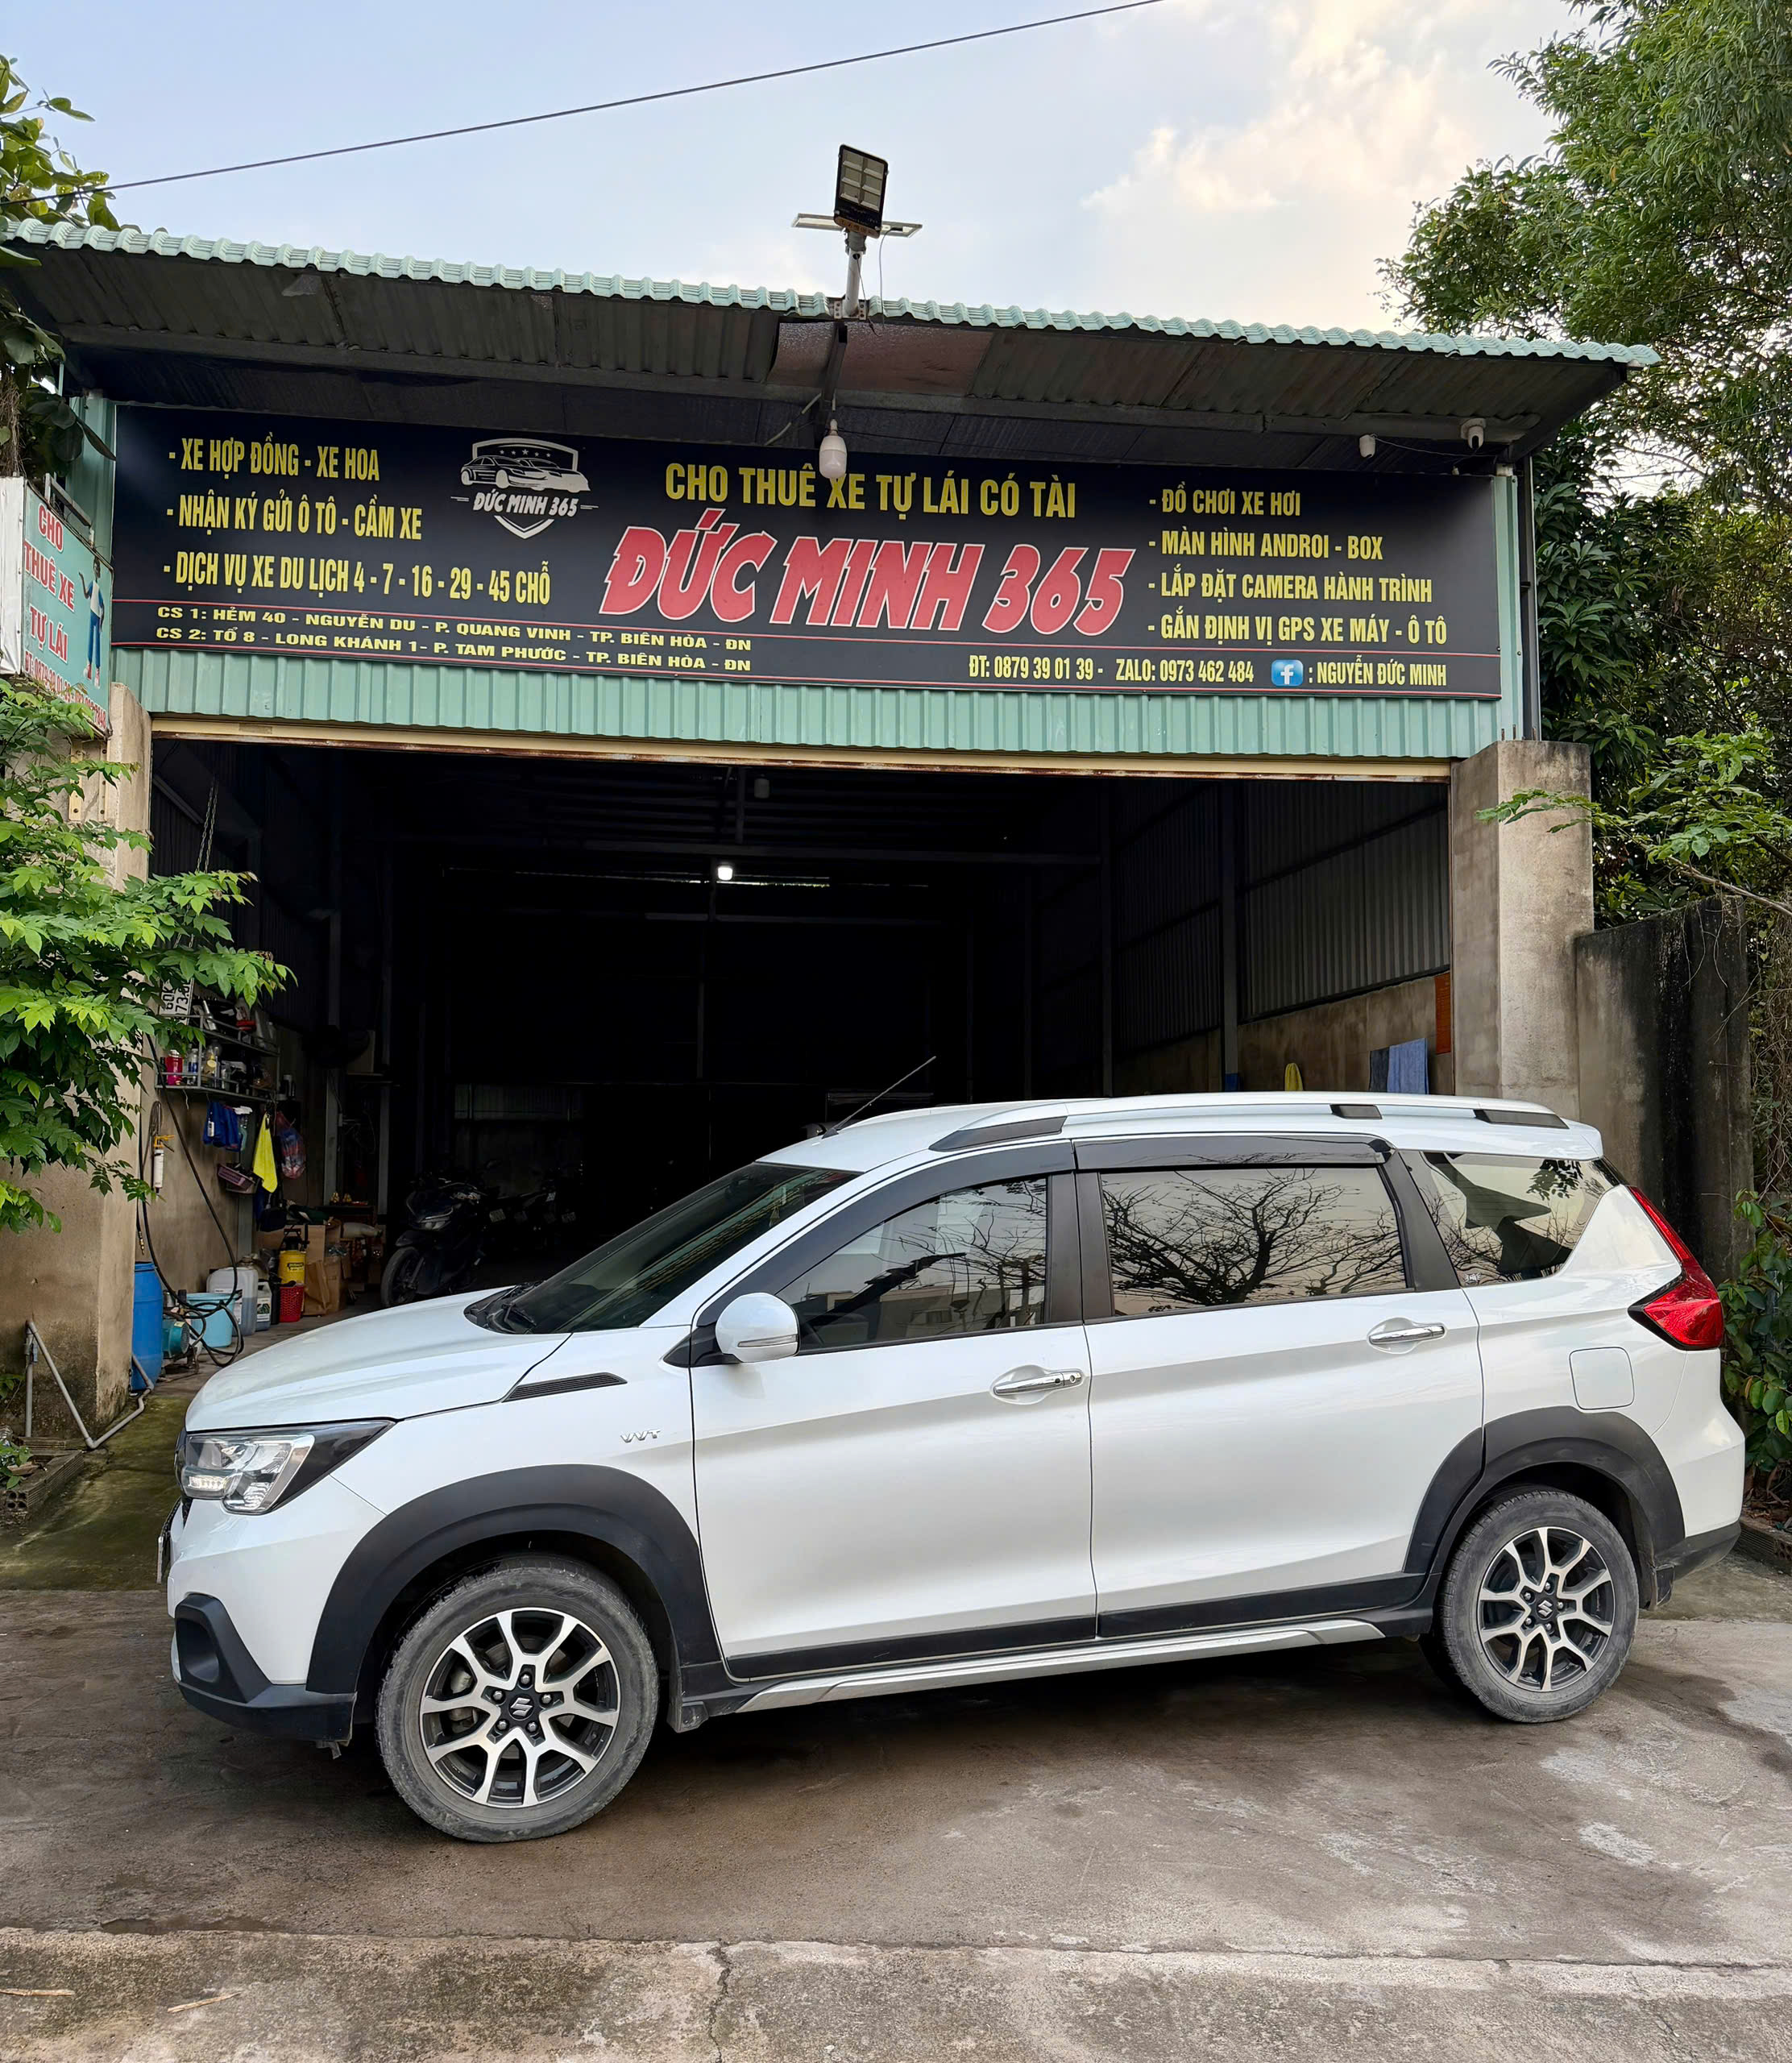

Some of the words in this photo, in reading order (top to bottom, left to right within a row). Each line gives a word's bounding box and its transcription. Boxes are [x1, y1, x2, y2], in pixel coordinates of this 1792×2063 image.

[180, 438, 203, 470] XE
[209, 437, 245, 479] HỢP
[250, 432, 298, 475] ĐỒNG
[317, 446, 338, 478] XE
[345, 447, 380, 481] HOA
[178, 489, 230, 535] NHẬN
[234, 492, 258, 529] KÝ
[263, 489, 292, 532] GỬI
[298, 494, 309, 533] Ô
[315, 496, 336, 534] TÔ
[355, 494, 394, 538] CẦM
[399, 507, 422, 540] XE
[473, 488, 507, 512] ĐỨC
[506, 495, 548, 515] MINH
[549, 496, 579, 517] 365
[666, 463, 728, 501] CHO
[739, 463, 816, 507] THUÊ
[827, 473, 865, 509] XE
[876, 472, 915, 520] TỰ
[923, 470, 968, 515] LÁI
[980, 472, 1019, 517] CÓ
[1030, 475, 1076, 518] TÀI
[1162, 481, 1187, 513] ĐỒ
[1193, 488, 1234, 514] CHƠI
[1242, 492, 1263, 515] XE
[1270, 491, 1300, 516] HƠI
[38, 504, 63, 552] CHO
[1162, 526, 1205, 555] MÀN
[1211, 527, 1255, 556] HÌNH
[1260, 533, 1329, 558] ANDROI
[1348, 536, 1383, 560] BOX
[24, 538, 56, 596] THUÊ
[59, 570, 74, 612] XE
[176, 551, 218, 592] DỊCH
[224, 554, 247, 593] VỤ
[251, 554, 274, 588] XE
[280, 557, 303, 590] DU
[309, 558, 348, 598] LỊCH
[353, 562, 363, 593] 4
[383, 563, 394, 594] 7
[412, 565, 432, 597] 16
[450, 567, 471, 600] 29
[477, 583, 483, 591] -
[488, 570, 509, 602] 45
[515, 561, 550, 604] CHỖ
[599, 508, 777, 622] ĐỨC
[769, 536, 985, 632] MINH
[981, 543, 1136, 636] 365
[1161, 564, 1196, 597] LẮP
[1201, 569, 1236, 603] ĐẶT
[1242, 575, 1318, 600] CAMERA
[1324, 571, 1373, 601] HÀNH
[1379, 572, 1433, 603] TRÌNH
[29, 604, 48, 650] TỰ
[48, 620, 68, 663] LÁI
[156, 628, 182, 638] CS
[189, 629, 205, 640] 2:
[213, 626, 239, 641] TỔ
[243, 633, 255, 642] 8
[276, 633, 327, 646] LONG
[334, 636, 400, 651] KHÁNH
[434, 642, 448, 653] P.
[456, 644, 495, 656] TAM
[501, 645, 566, 660] PHƯỚC
[587, 651, 611, 662] TP.
[618, 653, 662, 666] BIÊN
[668, 654, 705, 668] HÒA
[724, 660, 750, 670] ĐN
[158, 607, 183, 619] CS
[190, 608, 206, 620] 1:
[214, 606, 255, 621] HẺM
[262, 612, 285, 623] 40
[305, 613, 384, 629] NGUYỄN
[390, 619, 415, 630] DU
[435, 621, 450, 633] P.
[457, 624, 520, 637] QUANG
[526, 628, 570, 640] VINH
[590, 631, 614, 643] TP.
[621, 632, 666, 646] BIÊN
[670, 635, 707, 648] HÒA
[725, 639, 751, 650] ĐN
[1161, 605, 1198, 640] GẮN
[1205, 615, 1249, 644] ĐỊNH
[1255, 616, 1272, 645] VỊ
[1278, 616, 1315, 641] GPS
[1321, 617, 1344, 642] XE
[1350, 615, 1390, 643] MÁY
[1408, 615, 1418, 643] Ô
[1425, 616, 1446, 645] TÔ
[969, 655, 989, 677] ĐT:
[994, 656, 1028, 679] 0879
[1033, 657, 1050, 679] 39
[1055, 658, 1070, 679] 01
[1116, 659, 1155, 682] ZALO:
[1159, 659, 1194, 682] 0973
[1199, 660, 1224, 682] 462
[1228, 661, 1253, 682] 484
[1317, 655, 1373, 685] NGUYỄN
[1377, 659, 1404, 685] ĐỨC
[1410, 664, 1446, 686] MINH
